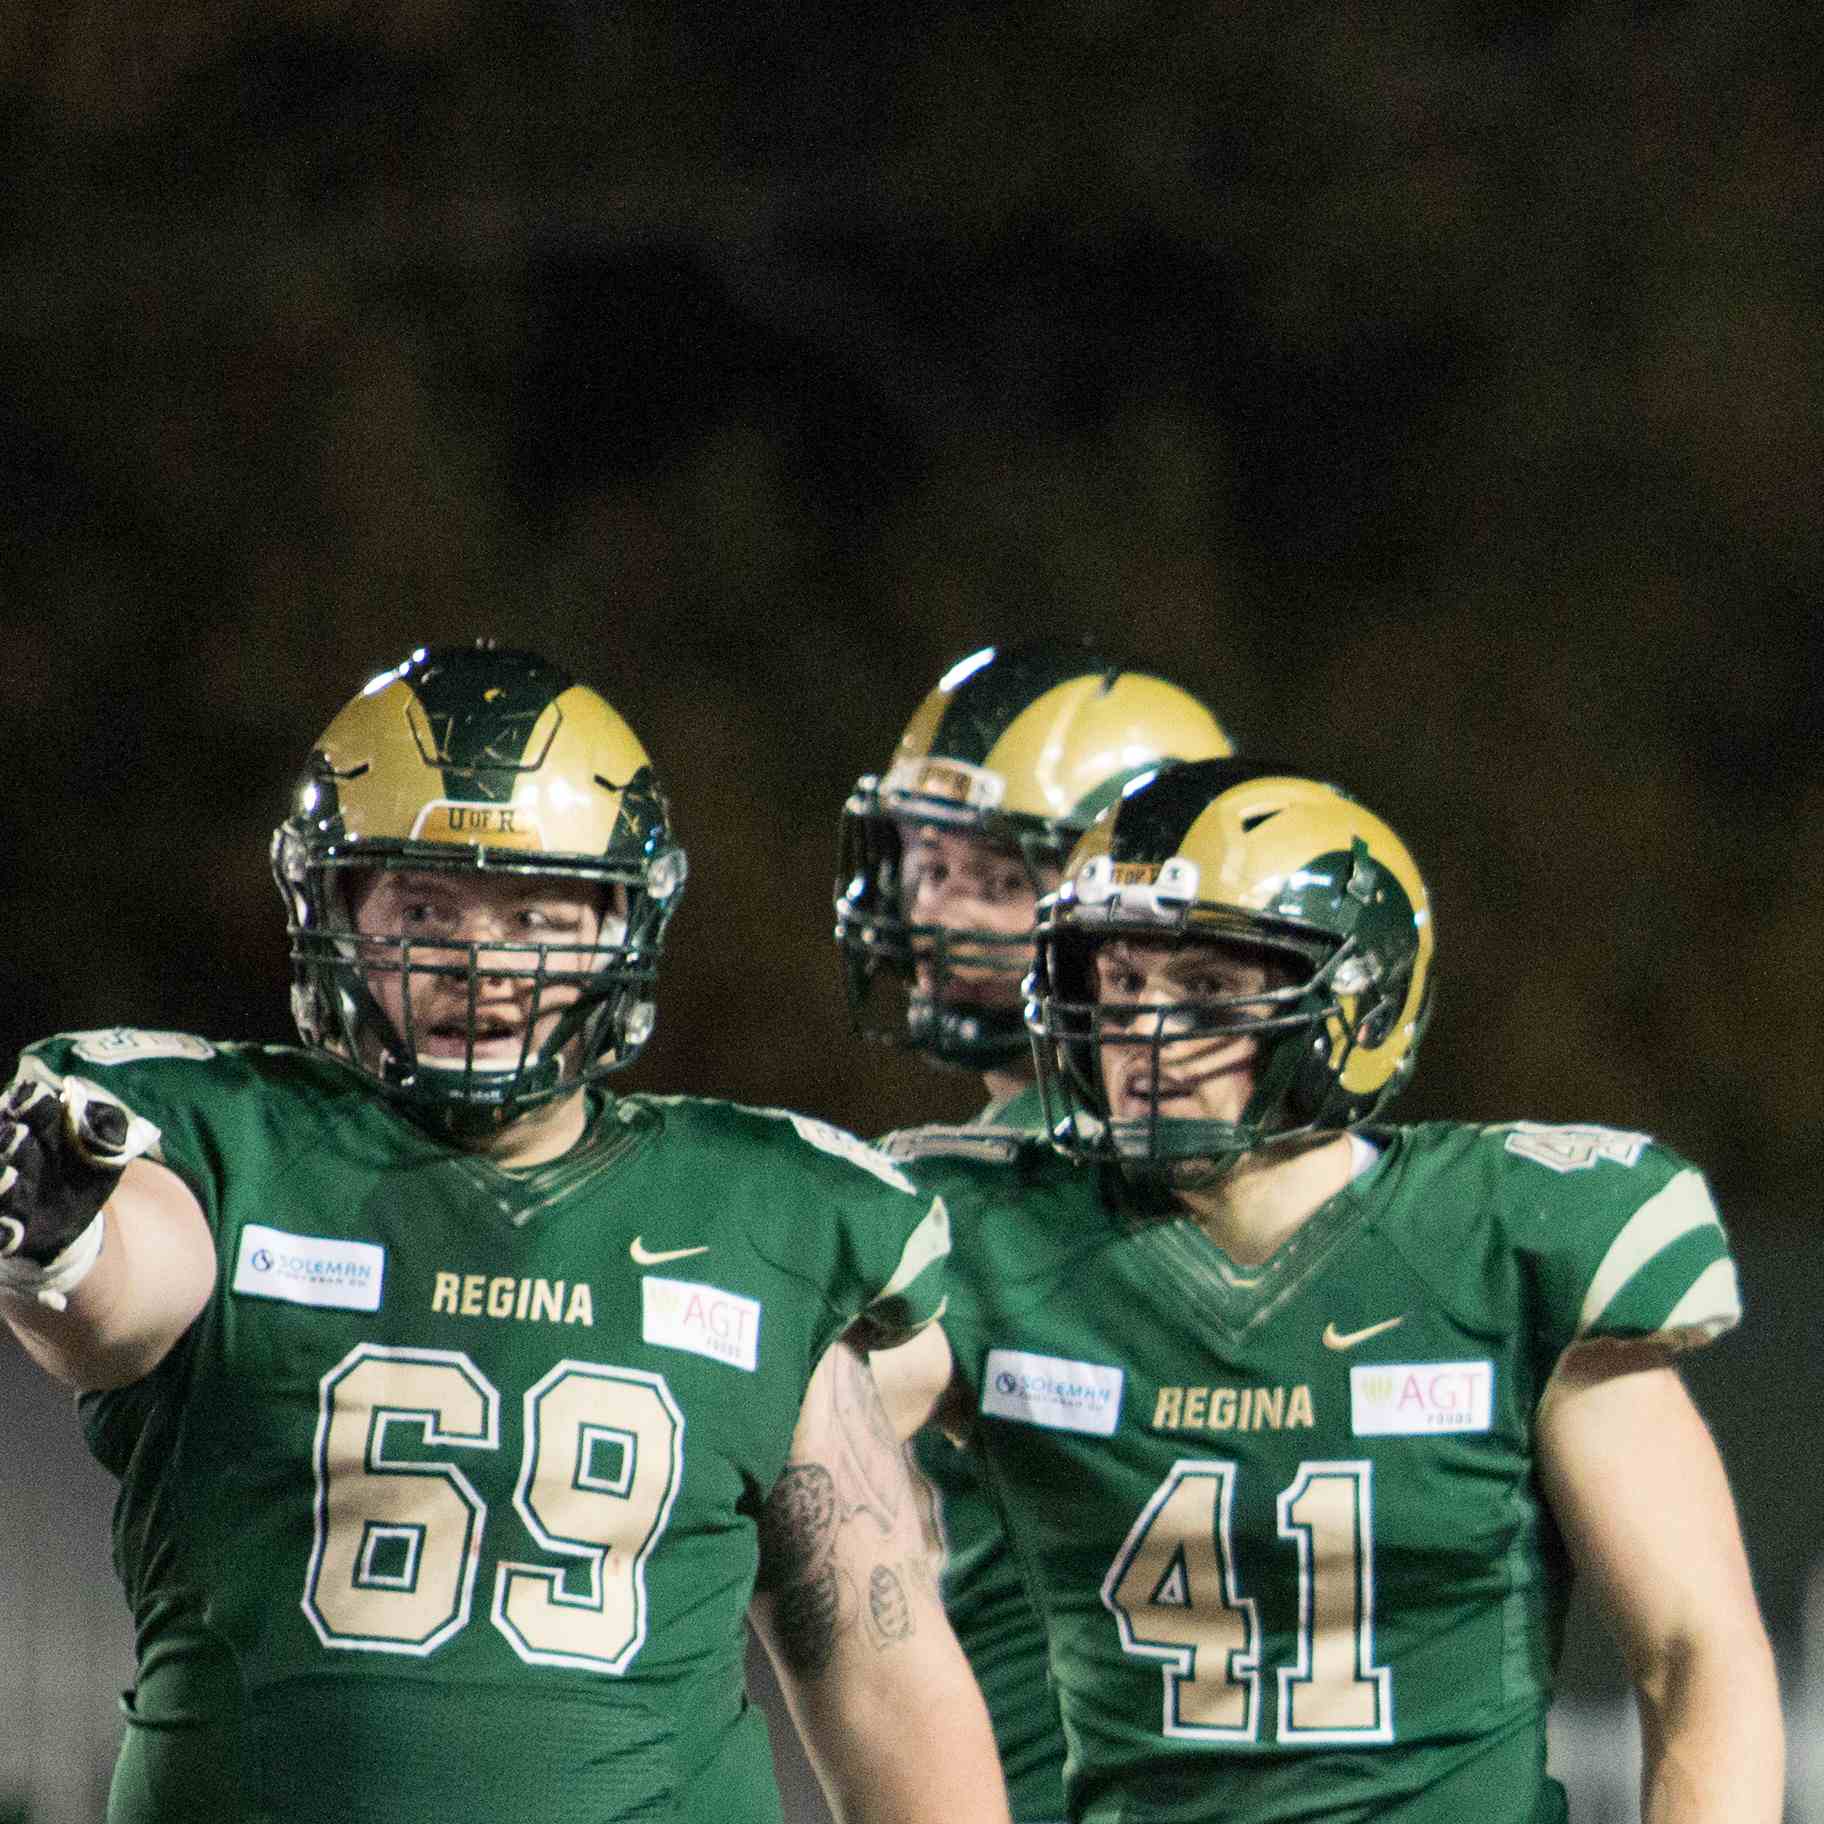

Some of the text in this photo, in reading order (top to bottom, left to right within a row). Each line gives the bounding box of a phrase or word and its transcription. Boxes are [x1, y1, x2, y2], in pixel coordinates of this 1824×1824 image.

[448, 807, 465, 832] U
[432, 1271, 593, 1327] REGINA
[682, 1293, 753, 1341] AGT
[1153, 1384, 1314, 1431] REGINA
[1397, 1372, 1484, 1410] AGT
[301, 1342, 685, 1674] 69
[1100, 1459, 1395, 1744] 41
